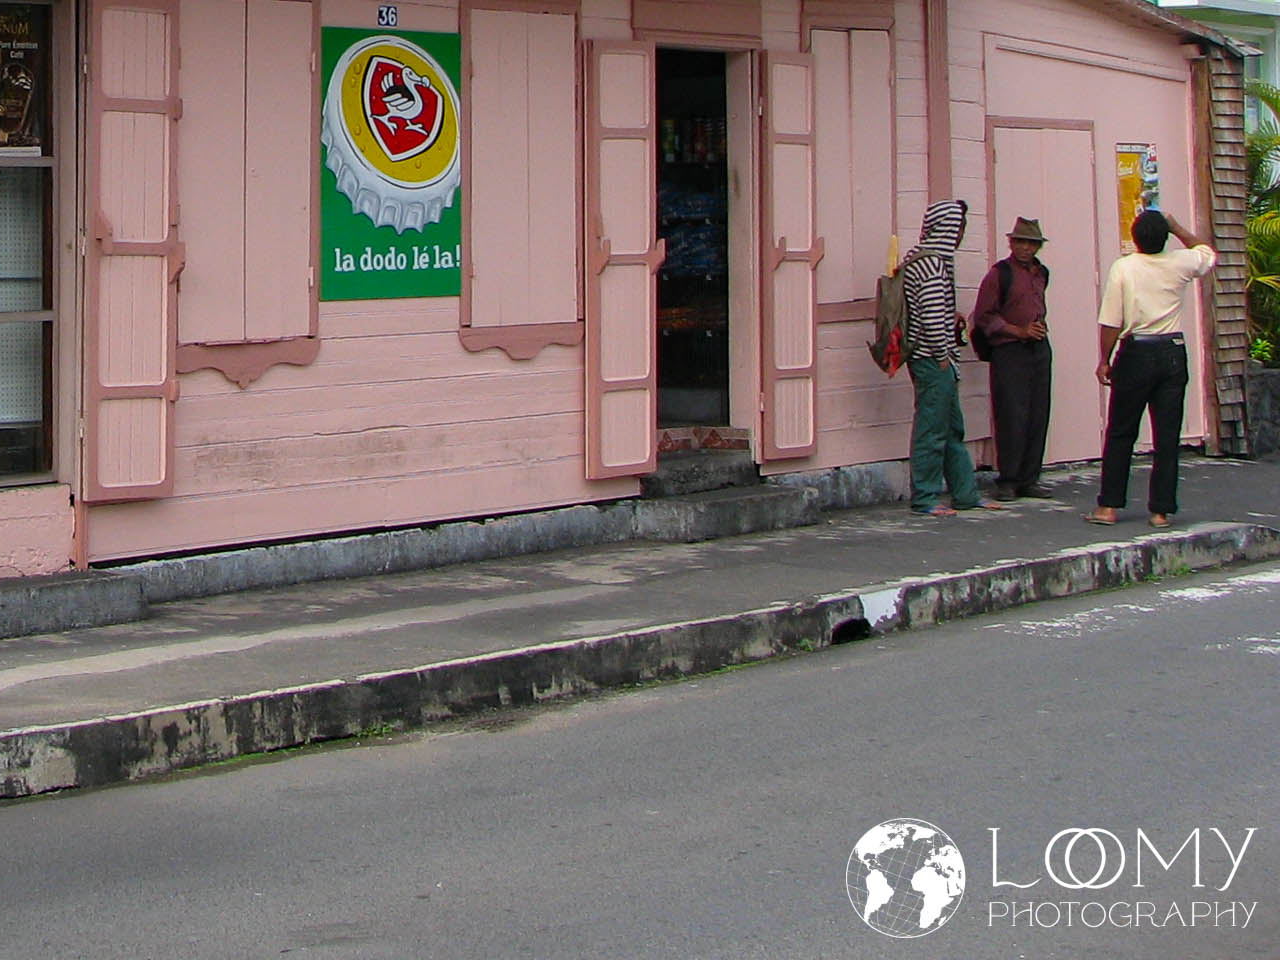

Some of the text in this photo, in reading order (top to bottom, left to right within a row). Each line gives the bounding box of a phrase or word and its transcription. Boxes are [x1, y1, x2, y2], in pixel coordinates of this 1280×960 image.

[379, 7, 397, 26] 36
[335, 244, 461, 272] la dodo lé la!
